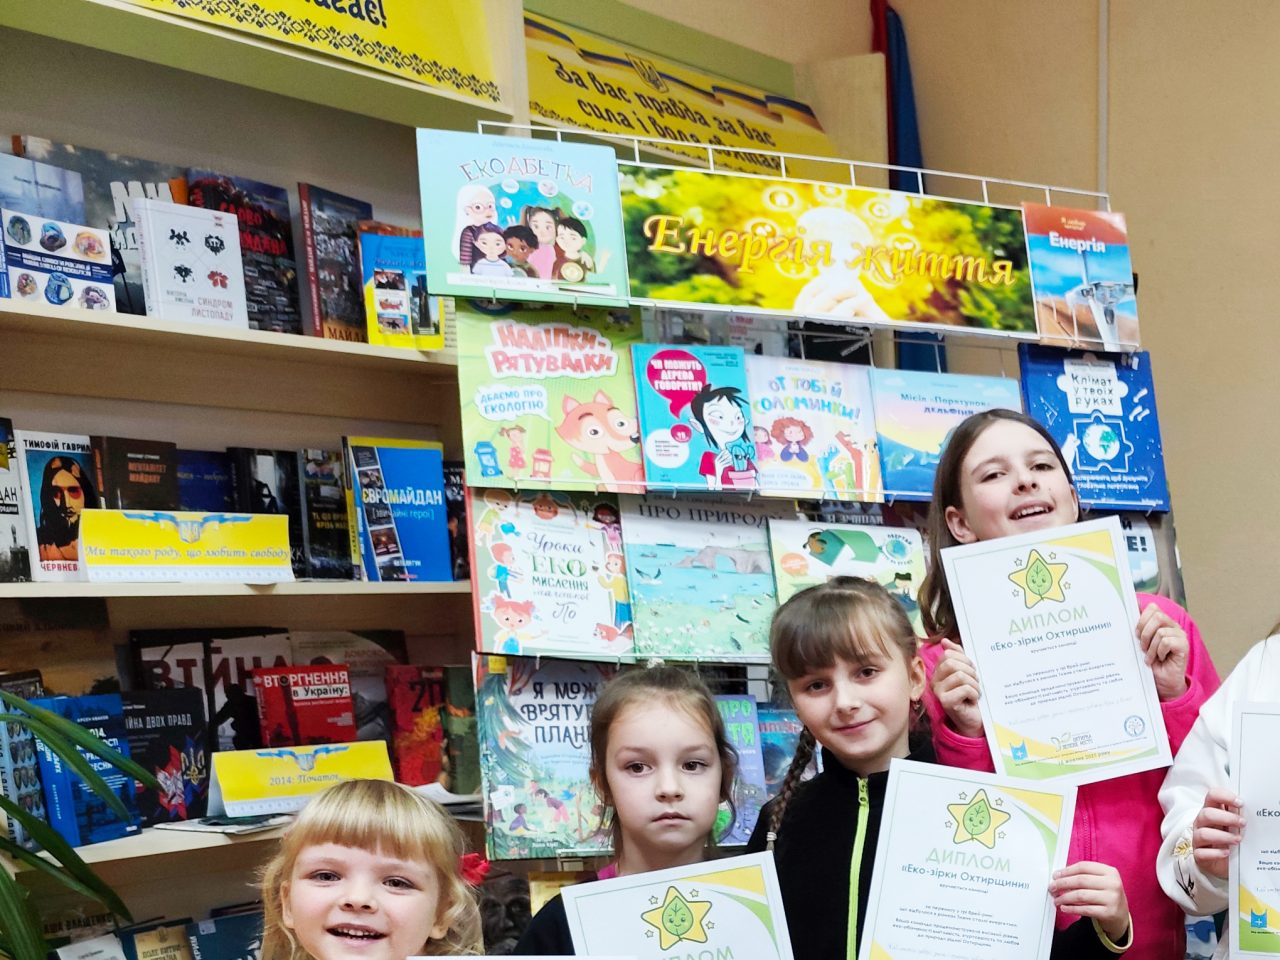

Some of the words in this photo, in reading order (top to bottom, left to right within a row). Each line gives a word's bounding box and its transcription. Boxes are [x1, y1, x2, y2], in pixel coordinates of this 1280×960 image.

[547, 55, 589, 90] За
[587, 72, 632, 104] вас
[634, 90, 711, 128] правда
[713, 116, 738, 136] за
[736, 119, 777, 147] вас
[642, 214, 834, 273] Енергія
[848, 240, 1016, 287] життя
[1049, 231, 1106, 254] Енергія
[197, 296, 233, 309] СИНДРОМ
[191, 307, 234, 321] ЛИСТОПАДУ
[490, 350, 613, 373] РЯТУВАЛКИ
[664, 360, 702, 371] МОЖУТЬ
[661, 370, 694, 381] ДЕРЕВА
[1071, 373, 1112, 386] Клімат
[769, 376, 786, 391] ОТ
[791, 376, 827, 395] ТОБІ
[1084, 386, 1113, 396] твоїх
[523, 389, 543, 399] ПРО
[901, 393, 927, 401] Місія
[484, 401, 544, 415] ЕКОЛОГІЮ
[753, 394, 861, 420] СОЛОМИНКИ!
[1075, 397, 1113, 408] руках
[23, 439, 60, 450] ТИМОФІЙ
[362, 486, 443, 506] ЄВРОМАЙДАН
[639, 505, 680, 520] ПРО
[689, 508, 783, 528] ПРИРОД
[527, 532, 583, 555] Уроки
[87, 546, 106, 556] Ми
[110, 548, 151, 559] такого
[186, 551, 202, 559] що
[206, 547, 246, 558] любить
[250, 548, 289, 561] свободу
[530, 553, 587, 577] ЕКО
[532, 576, 589, 591] МИСЛЕННЯ
[1008, 605, 1088, 636] ДИПЛОМ
[991, 634, 1043, 652] «Еко-зірки
[1045, 621, 1112, 642] Охтирщини»
[264, 671, 349, 687] ВТОРГНЕННЯ
[304, 686, 348, 700] Україну:
[533, 682, 544, 699] Я
[554, 682, 599, 700] МОЖ
[146, 716, 165, 728] ДВОХ
[168, 714, 192, 726] ПРАВД
[926, 847, 1011, 872] ДИПЛОМ
[902, 864, 957, 882] «Еко-зірки
[960, 871, 1030, 890] Охтирщини»
